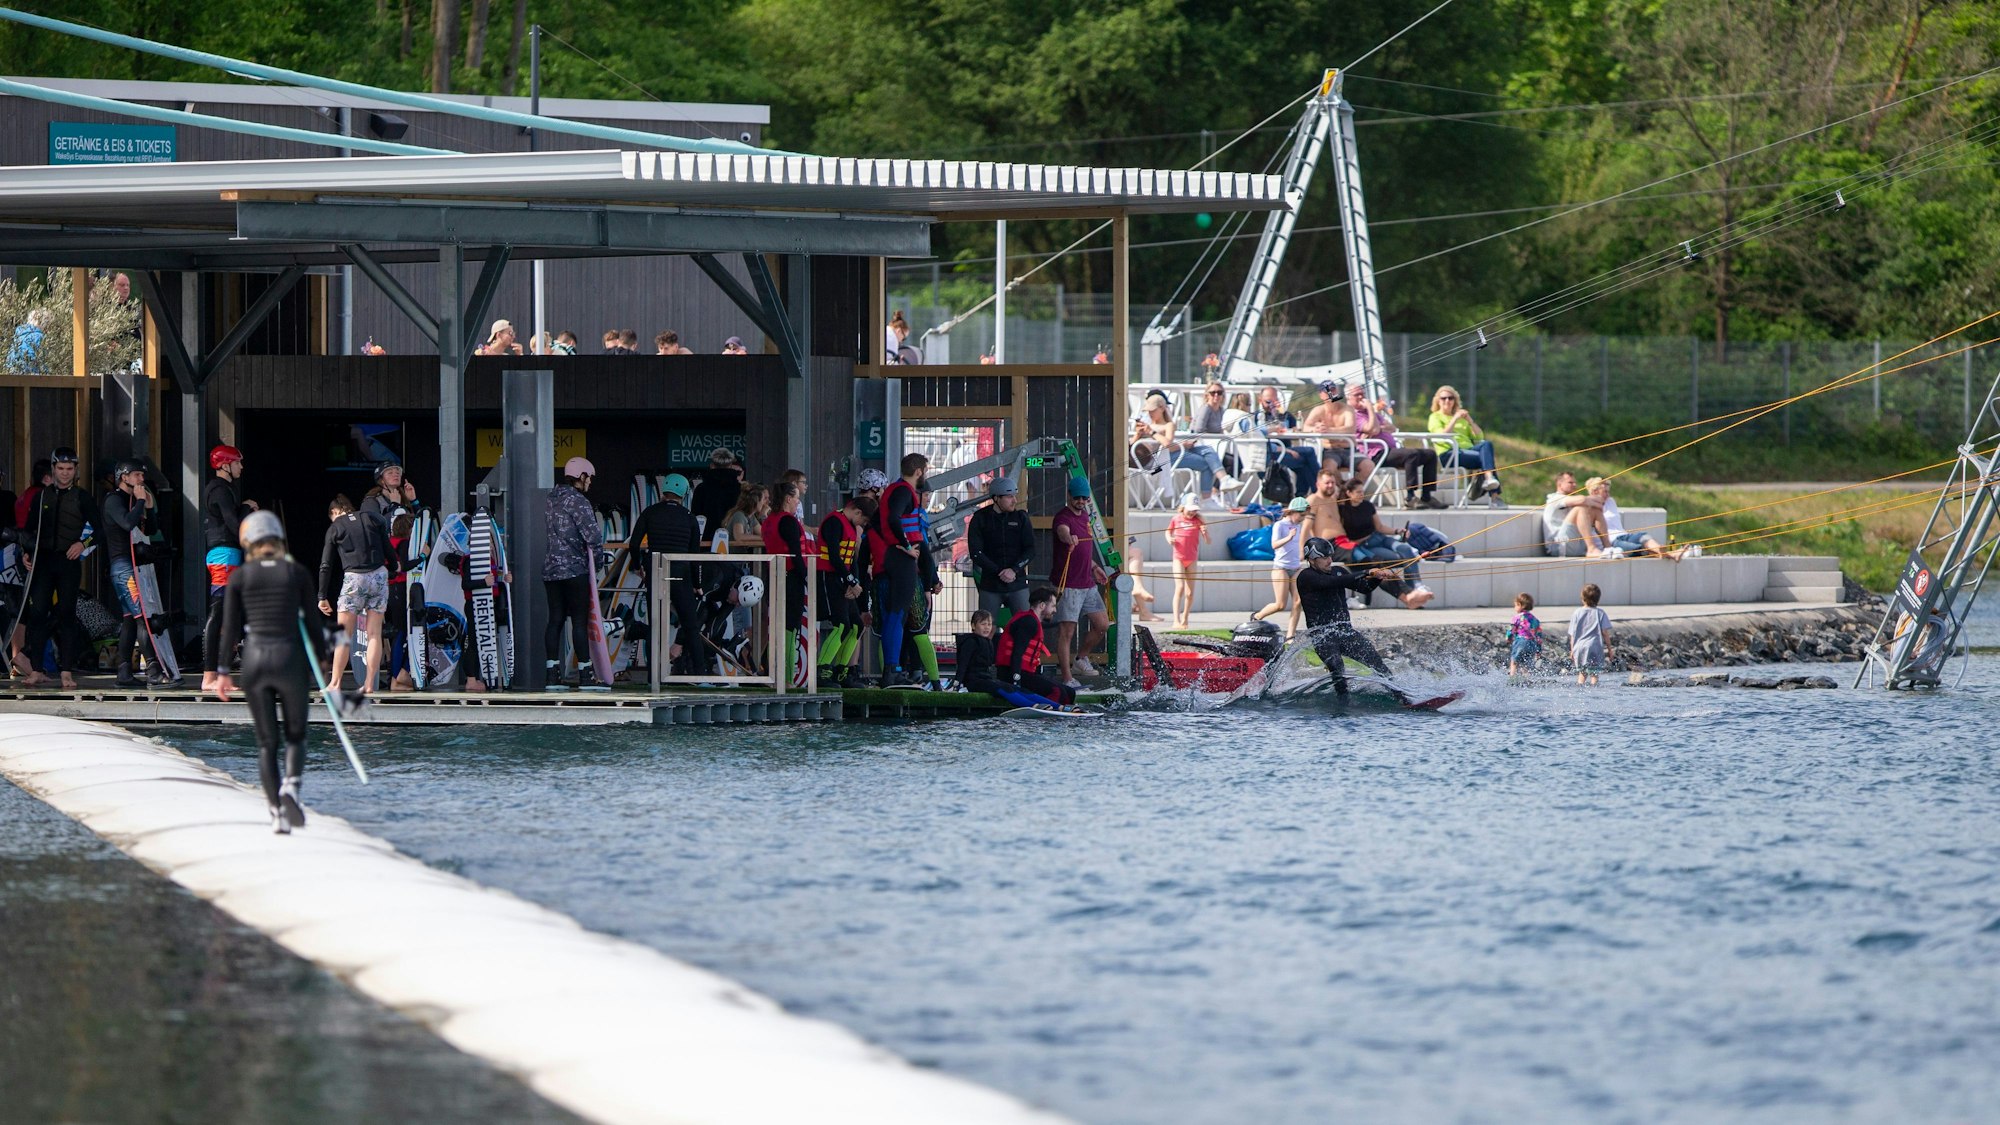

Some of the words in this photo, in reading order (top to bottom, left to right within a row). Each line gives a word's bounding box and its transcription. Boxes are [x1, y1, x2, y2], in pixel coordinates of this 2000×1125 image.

[55, 135, 101, 151] GETRÄNKE
[104, 138, 110, 152] &
[112, 138, 126, 152] EIS
[127, 139, 134, 152] &
[135, 139, 171, 154] TICKETS
[680, 434, 746, 448] WASSER
[869, 426, 882, 447] 5
[476, 598, 492, 651] RENTAL
[1234, 635, 1272, 643] MERCURY
[481, 653, 494, 674] SKI
